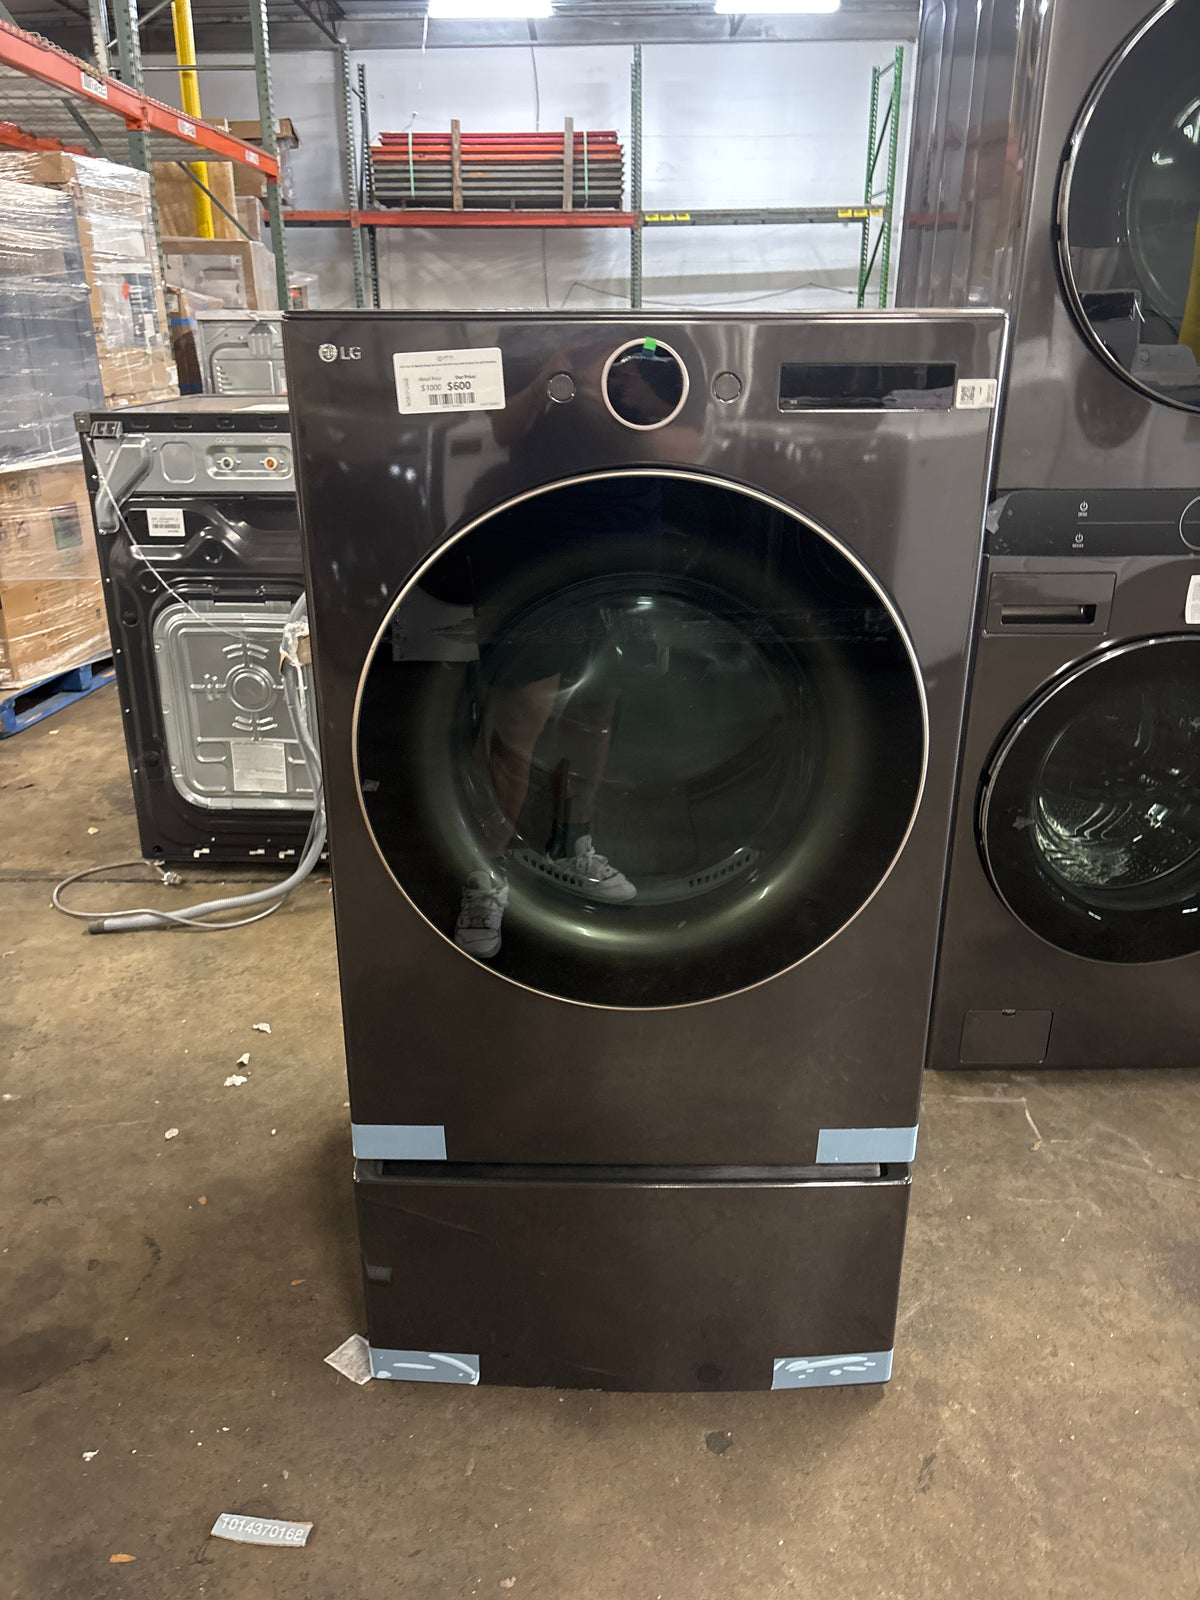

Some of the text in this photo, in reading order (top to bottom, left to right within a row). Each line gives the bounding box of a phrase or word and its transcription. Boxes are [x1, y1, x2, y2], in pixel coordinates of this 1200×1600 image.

[340, 346, 362, 360] LG
[420, 384, 442, 392] $1000
[447, 381, 471, 391] $600
